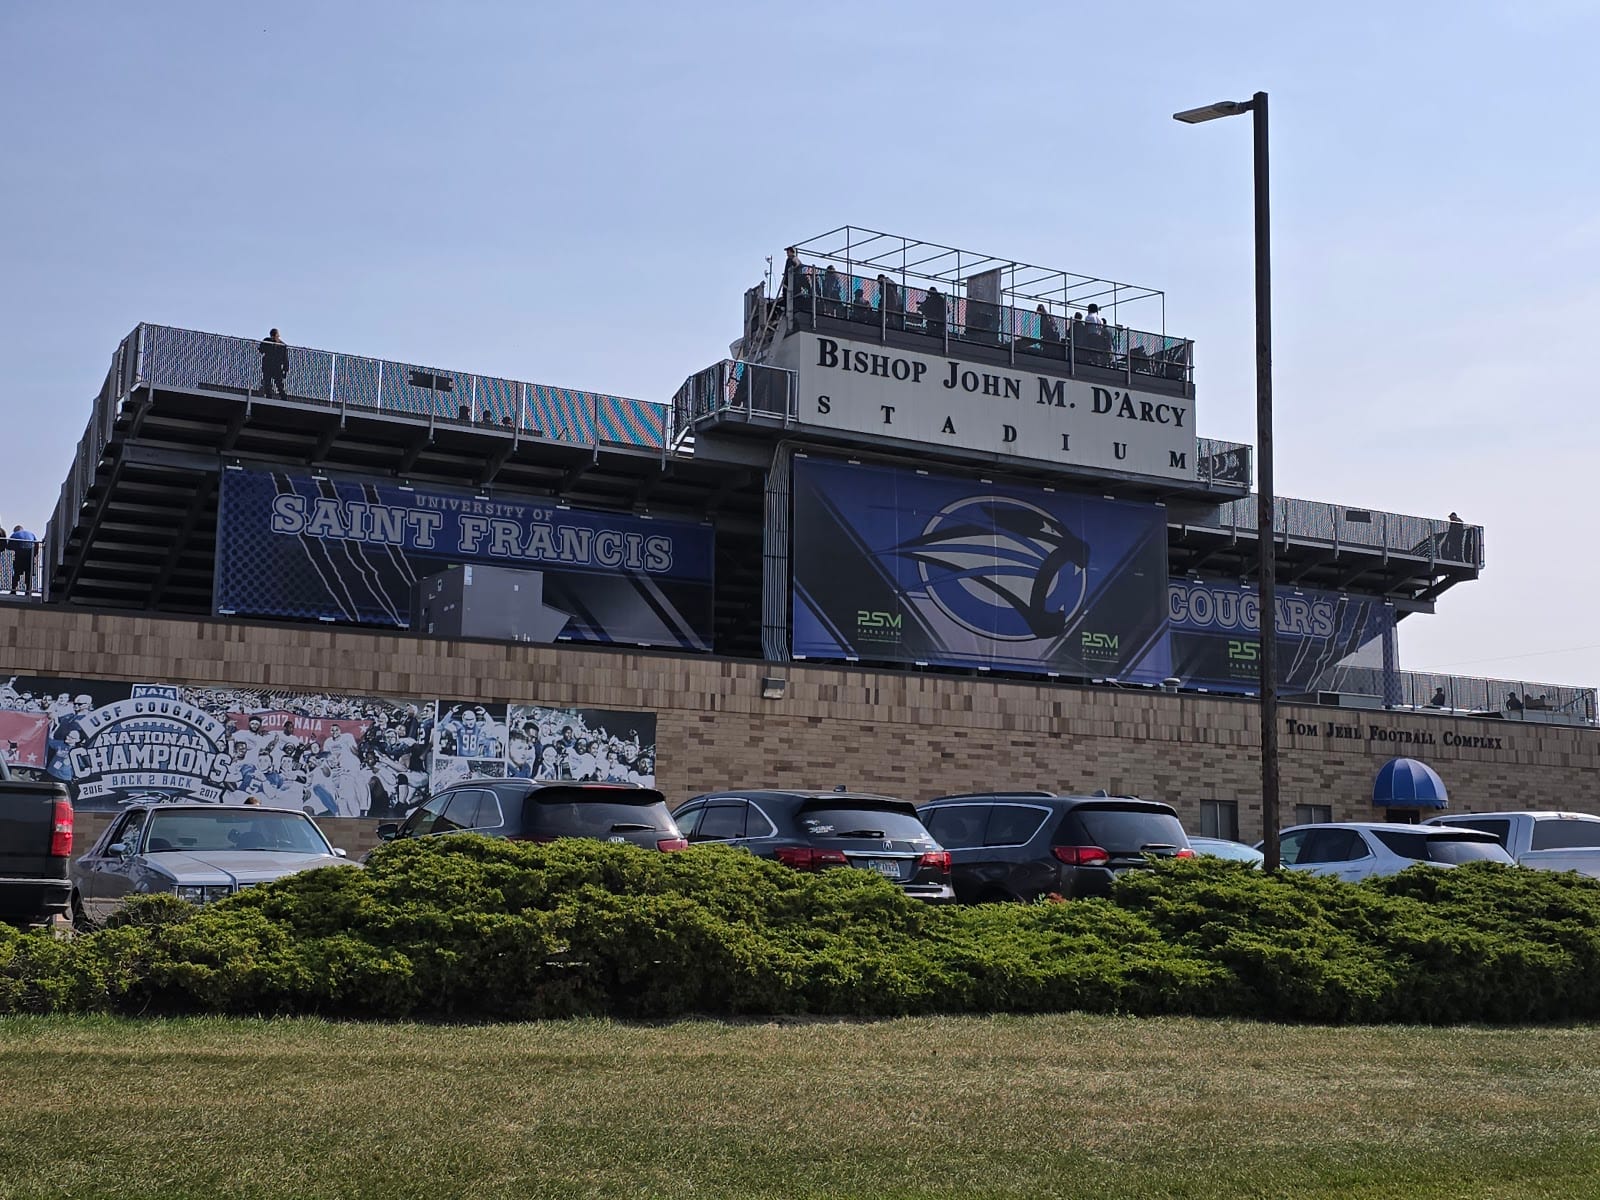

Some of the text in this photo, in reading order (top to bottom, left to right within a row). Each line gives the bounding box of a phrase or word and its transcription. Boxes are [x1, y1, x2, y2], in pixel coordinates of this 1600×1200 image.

[816, 338, 927, 383] BISHOP
[943, 362, 1021, 399] JOHN
[1037, 376, 1076, 408] M.
[415, 494, 554, 522] UNIVERSITY OF
[271, 493, 675, 573] SAINT FRANCIS
[857, 610, 902, 629] PSM
[1081, 631, 1119, 649] PSM
[1228, 640, 1261, 660] PS
[135, 687, 175, 699] NAIA
[90, 702, 216, 733] USF COUGARS
[261, 714, 322, 731] 2017 NAIA
[100, 730, 205, 750] NATIONAL
[462, 734, 477, 751] 98
[1286, 718, 1318, 737] TOM
[1370, 725, 1436, 745] FOOTBALL
[1443, 731, 1502, 750] COMPLEX
[69, 744, 232, 783] CHAMPIONS
[83, 785, 103, 796] 2016
[112, 775, 193, 789] BACK 2 BACK
[200, 787, 219, 799] 2017
